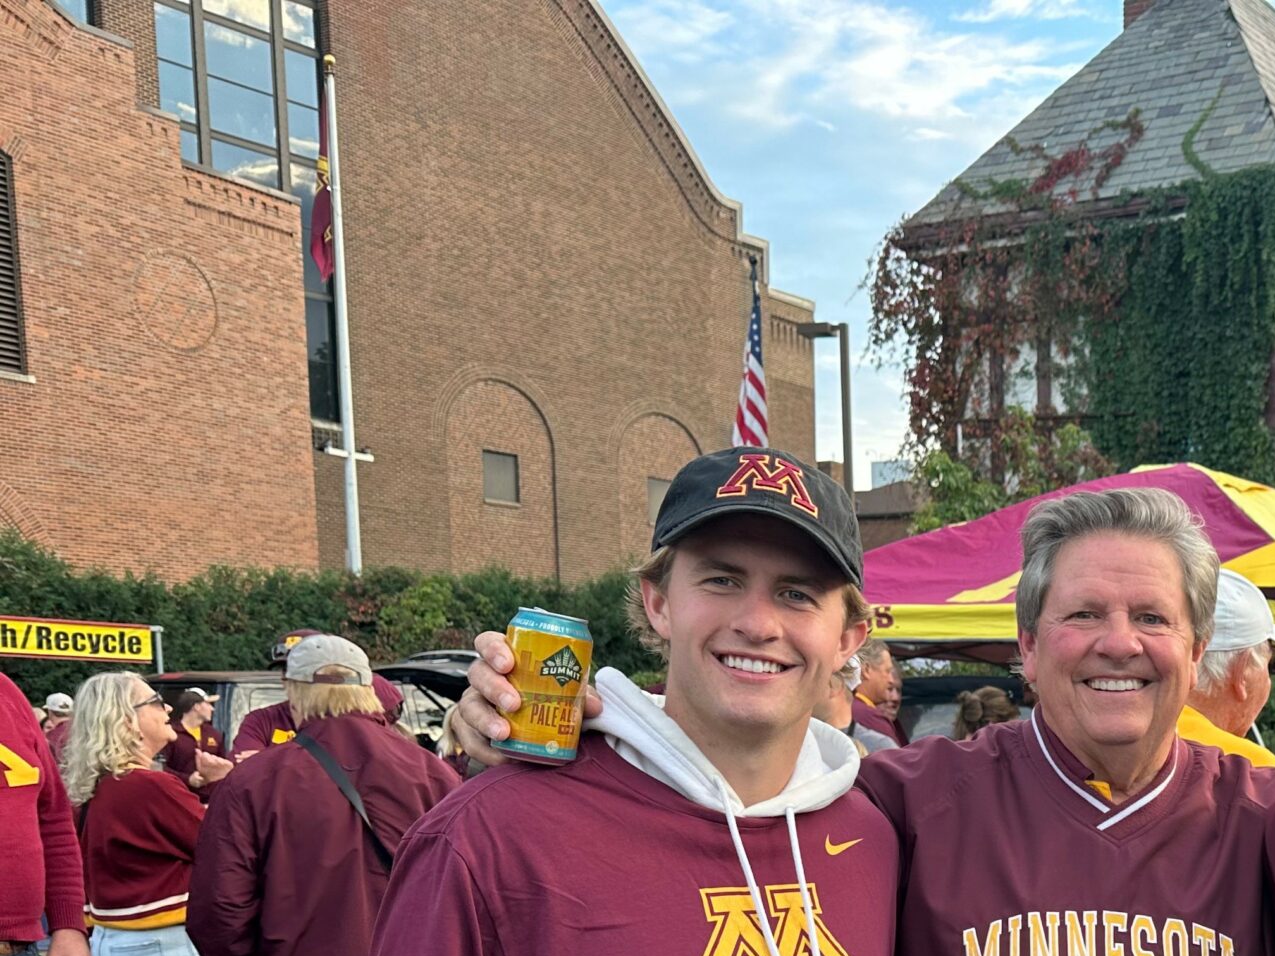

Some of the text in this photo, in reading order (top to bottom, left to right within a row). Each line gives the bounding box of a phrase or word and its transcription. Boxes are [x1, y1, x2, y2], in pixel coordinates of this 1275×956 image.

[716, 454, 818, 519] M
[0, 623, 142, 655] h/Recycle
[542, 666, 581, 680] SUMMIT
[530, 703, 560, 728] PALE
